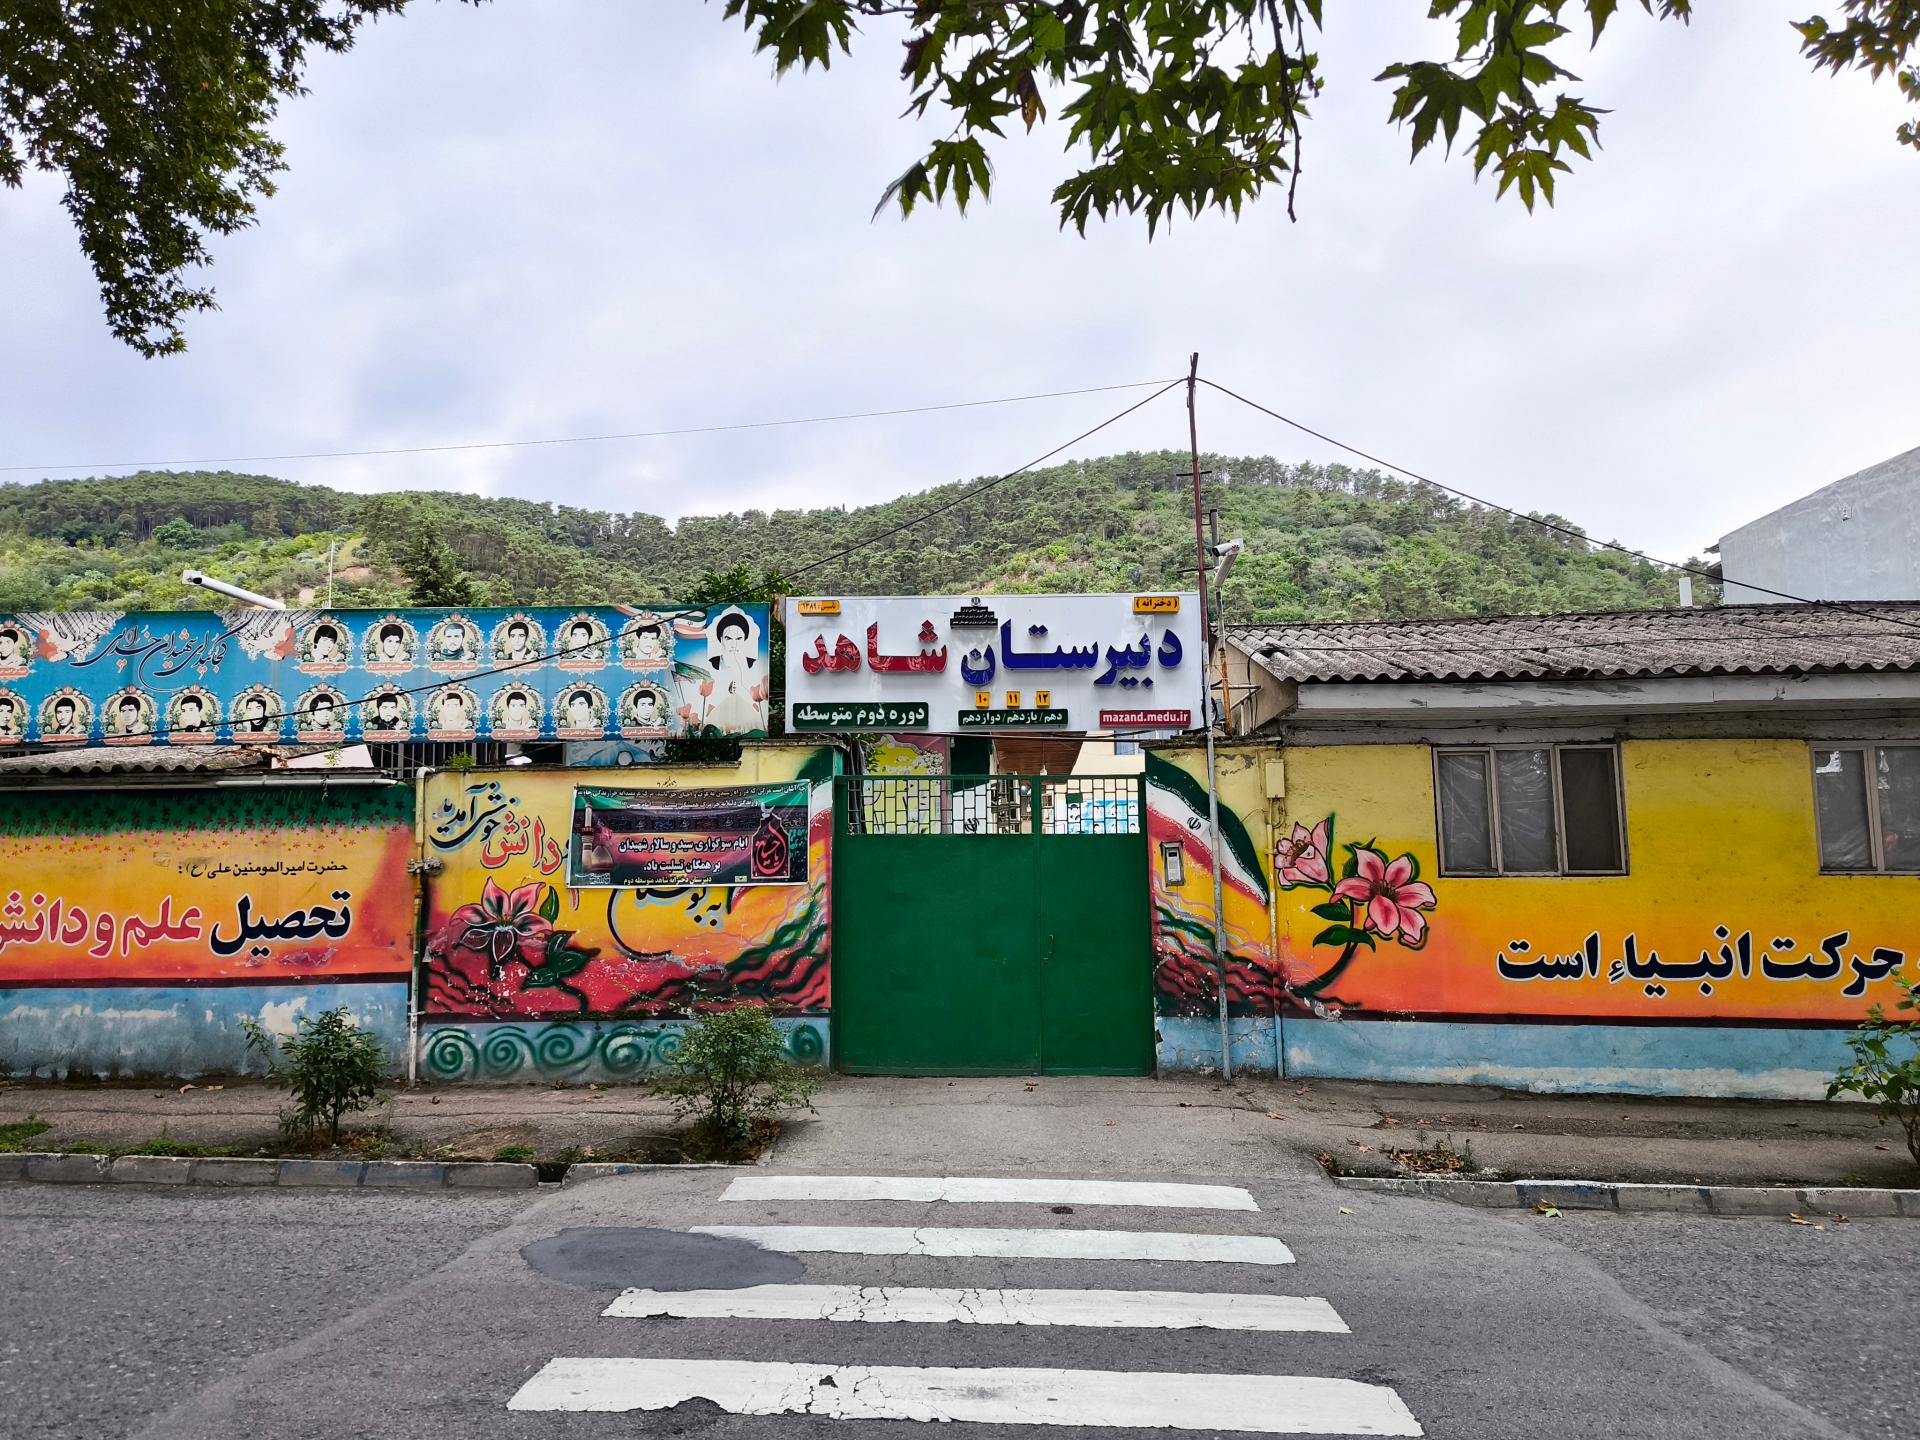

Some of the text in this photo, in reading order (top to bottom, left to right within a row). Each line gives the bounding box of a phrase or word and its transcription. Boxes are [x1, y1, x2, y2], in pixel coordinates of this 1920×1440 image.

[803, 619, 1183, 688] دبیرستان شاهد
[1009, 694, 1018, 703] ۱۱
[1038, 693, 1049, 703] ۱۲
[797, 705, 925, 726] دوره دوم متوسطه
[1102, 711, 1188, 722] mazand.medu.ir
[619, 836, 748, 853] ایام سوگواری سید و سالار شهیدان
[207, 861, 231, 879] علی
[307, 860, 348, 876] حضرت
[659, 859, 685, 873] تسلیت
[685, 858, 711, 873] همگان
[712, 860, 721, 873] بر
[623, 877, 634, 886] دوم
[121, 895, 203, 956] علم
[210, 890, 352, 957] تحصیل
[88, 912, 117, 957] و
[1496, 930, 1601, 983] است
[1761, 930, 1905, 998] حرکت
